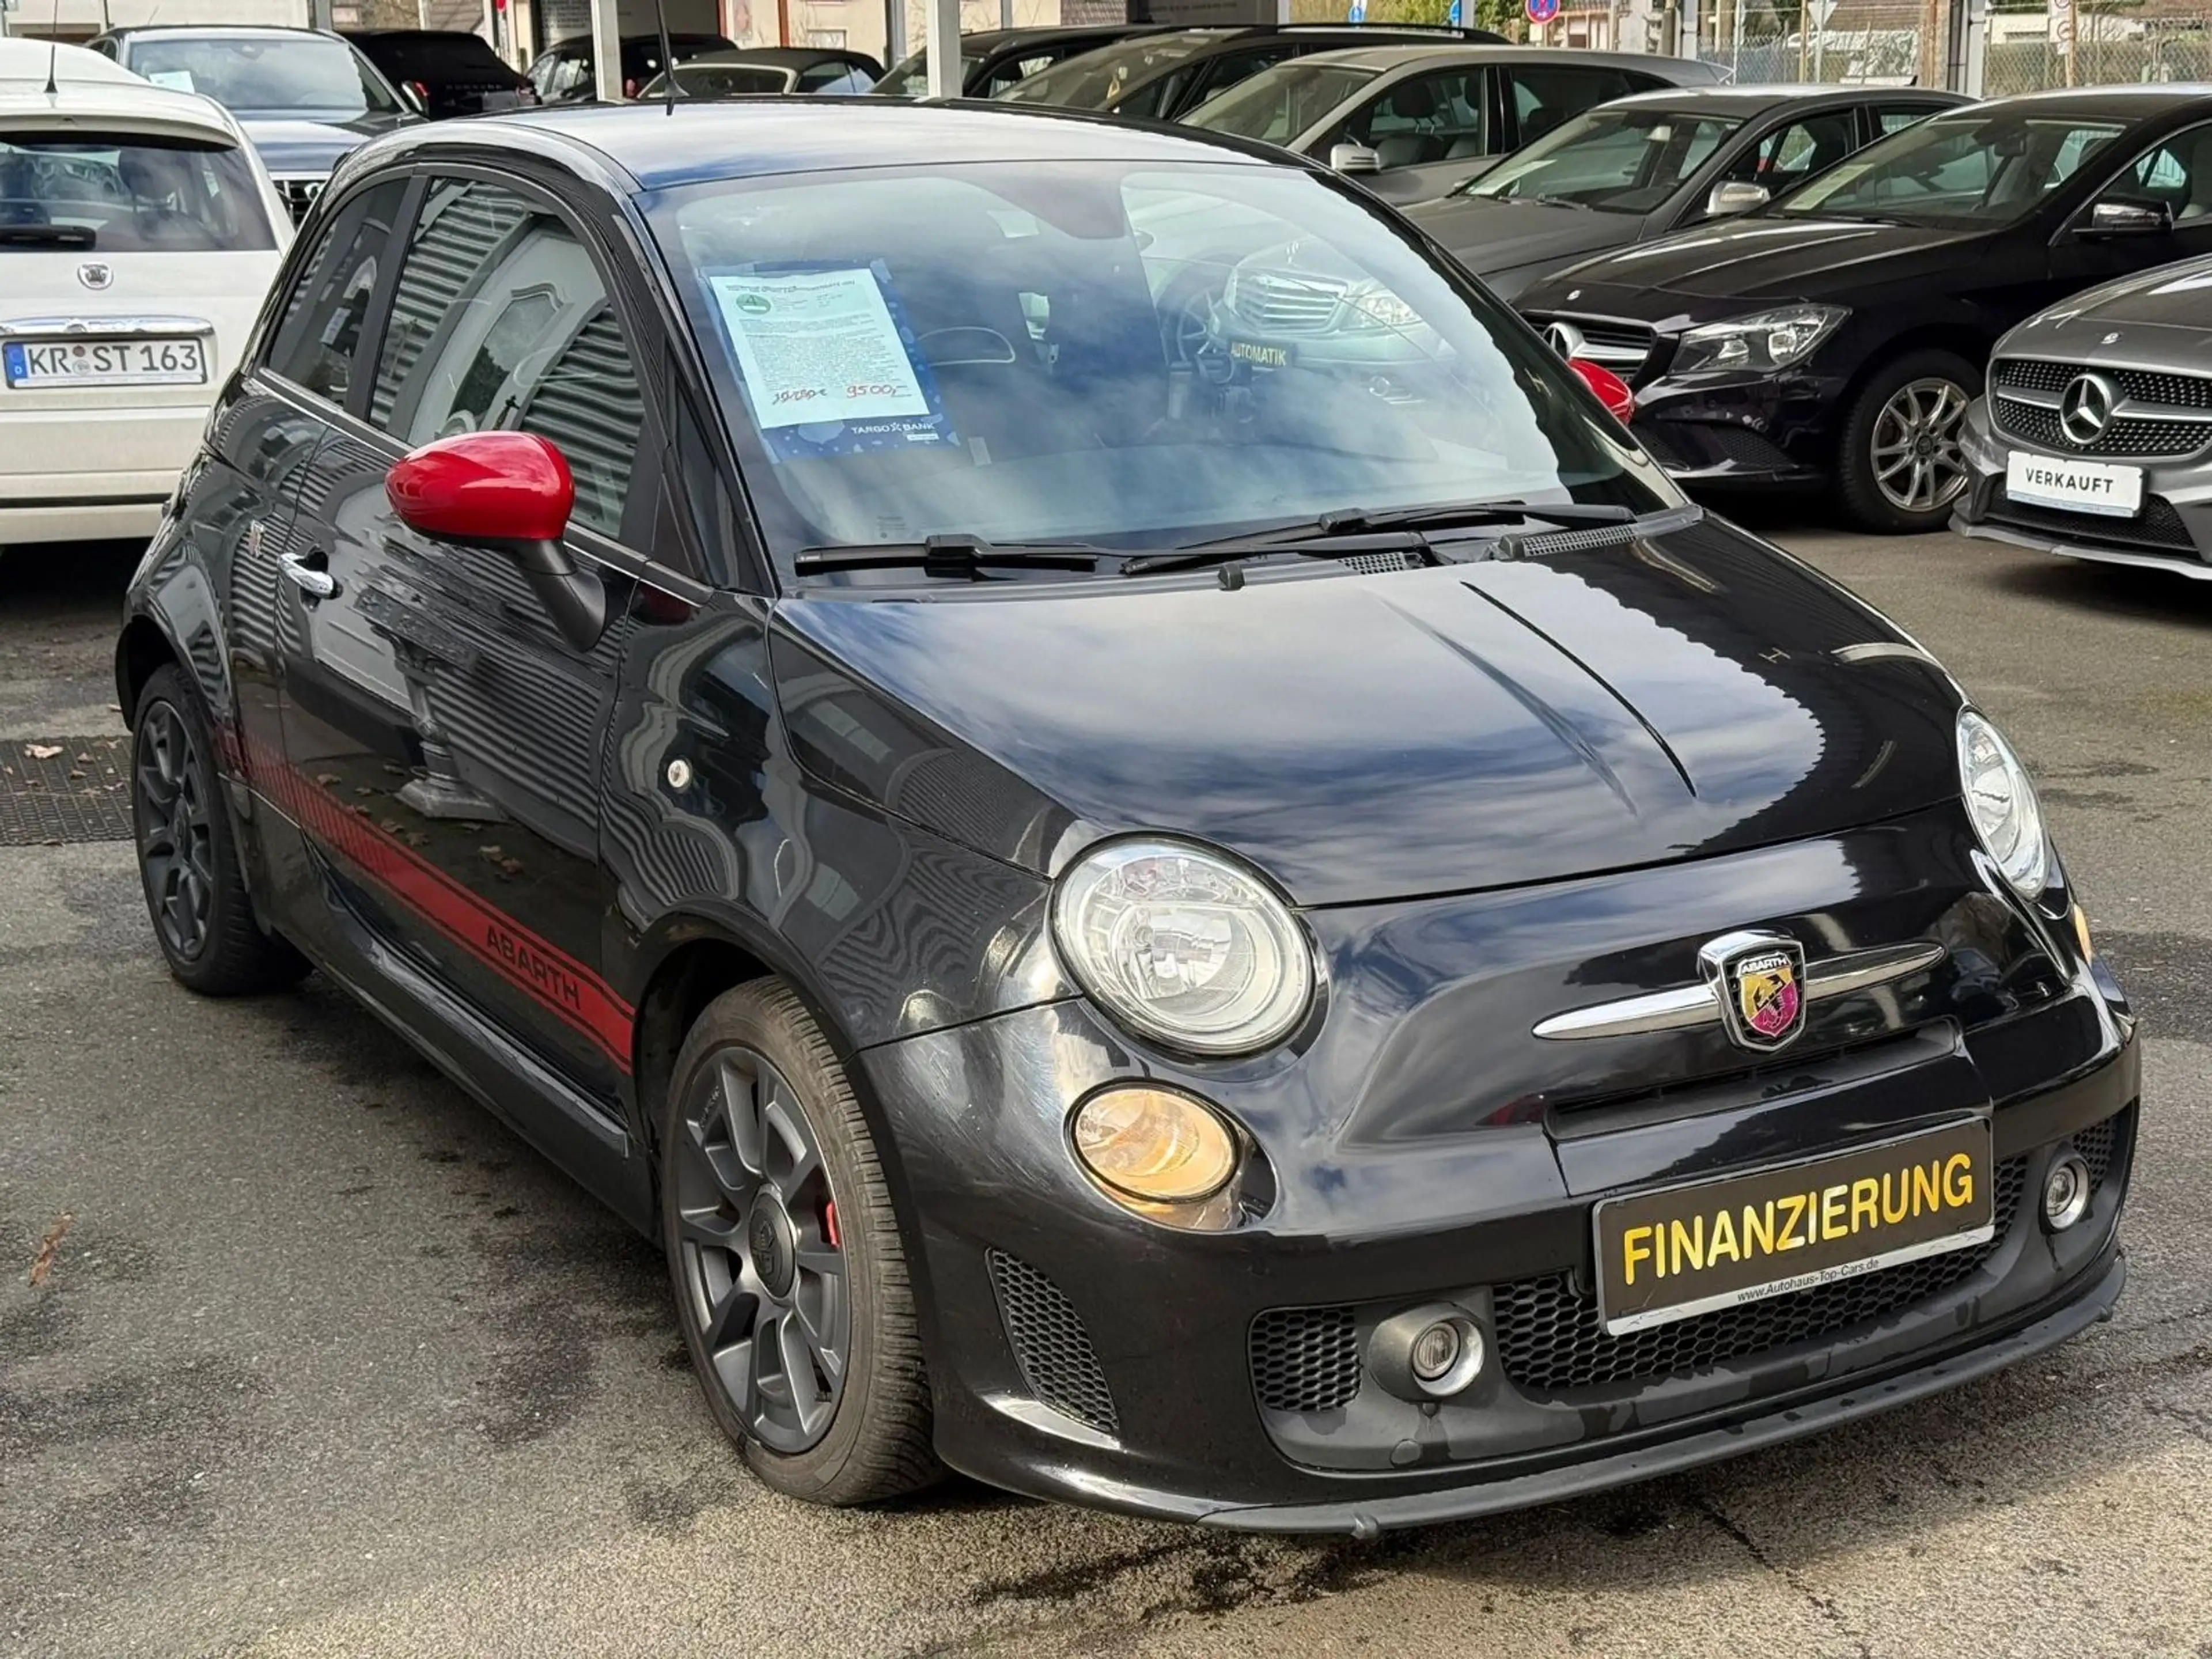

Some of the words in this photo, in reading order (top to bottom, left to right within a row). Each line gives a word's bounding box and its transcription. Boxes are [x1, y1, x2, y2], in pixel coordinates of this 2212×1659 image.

[29, 347, 70, 374] KR
[92, 346, 130, 372] ST
[140, 345, 198, 372] 163
[1230, 342, 1286, 366] AUTOMATIK
[851, 425, 890, 434] TARGO
[902, 422, 935, 431] BANK
[2025, 467, 2113, 494] VERKAUFT
[487, 925, 581, 1010] ABARTH
[1741, 957, 1787, 973] ABARTH
[1624, 1153, 1974, 1285] FINANZIERUNG
[1737, 1258, 1880, 1302] www.Autohaus-Top-Cars.de
